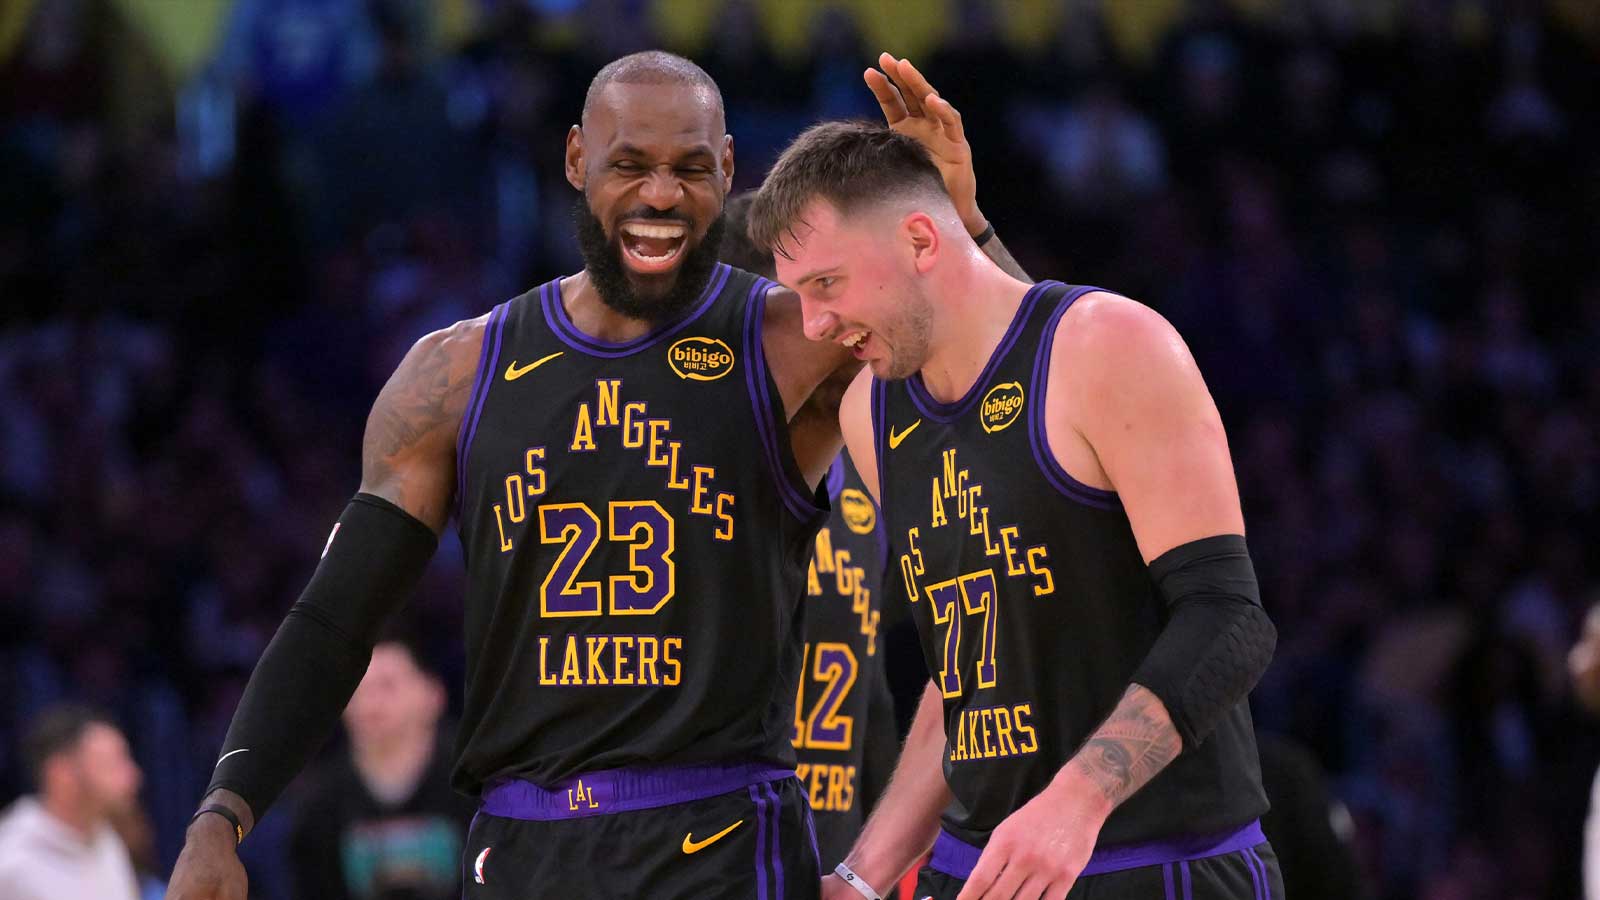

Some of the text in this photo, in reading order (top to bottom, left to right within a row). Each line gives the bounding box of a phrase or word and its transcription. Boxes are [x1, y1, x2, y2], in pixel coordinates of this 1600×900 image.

[675, 347, 730, 368] bibigo
[985, 395, 1021, 416] bibigo
[494, 380, 735, 552] LOS ANGELES
[538, 499, 675, 618] 23
[900, 449, 1054, 602] OS ANGELES
[538, 635, 683, 686] LAKERS
[924, 568, 998, 699] 77
[791, 642, 858, 750] 2
[950, 704, 1038, 761] AKERS
[568, 779, 599, 810] LAL
